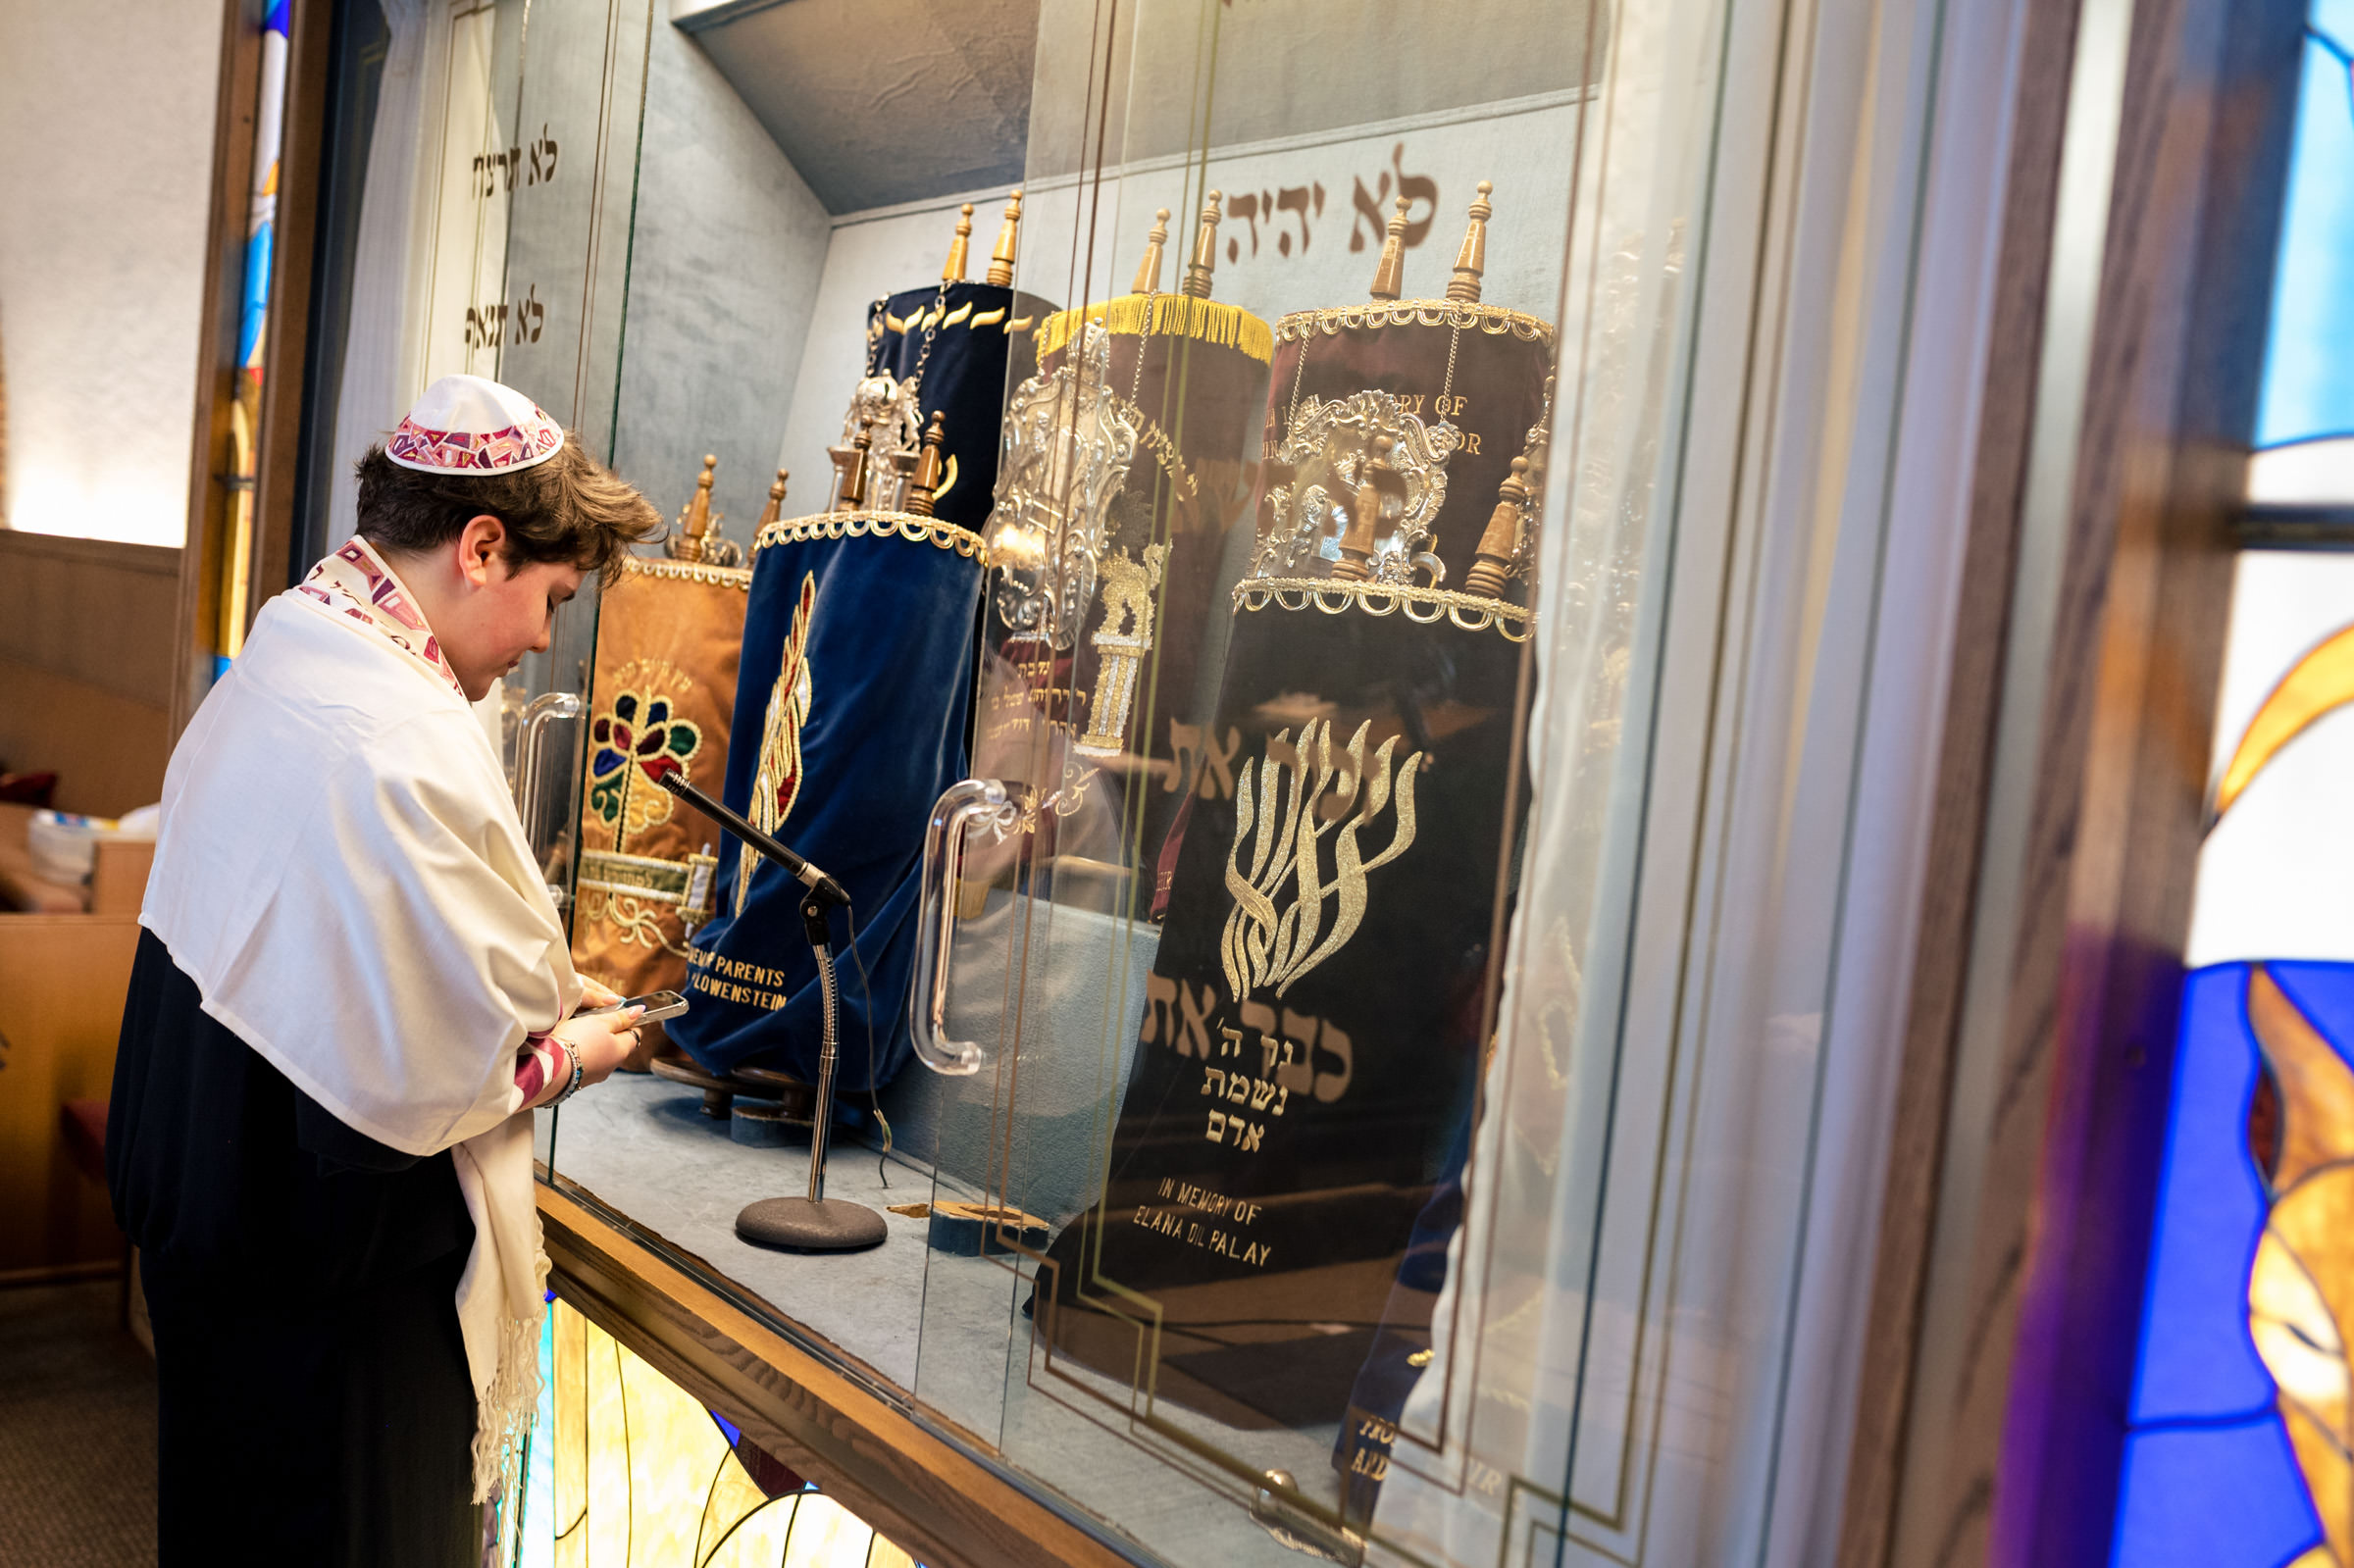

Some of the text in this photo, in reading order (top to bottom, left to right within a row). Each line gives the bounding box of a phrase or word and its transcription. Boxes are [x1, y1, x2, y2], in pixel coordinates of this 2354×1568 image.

[529, 123, 558, 186] לא
[1227, 141, 1438, 265] לא יהיה
[515, 282, 543, 345] לא
[1435, 394, 1468, 416] OF
[1163, 717, 1241, 800] את
[715, 955, 785, 987] PARENTS
[1141, 969, 1216, 1060] את
[1201, 1066, 1289, 1116] נשמת
[1205, 1108, 1265, 1153] אדם
[1157, 1177, 1262, 1226] IN MEMORY OF
[1133, 1205, 1183, 1239] ELANA
[1208, 1229, 1272, 1268] PALAY
